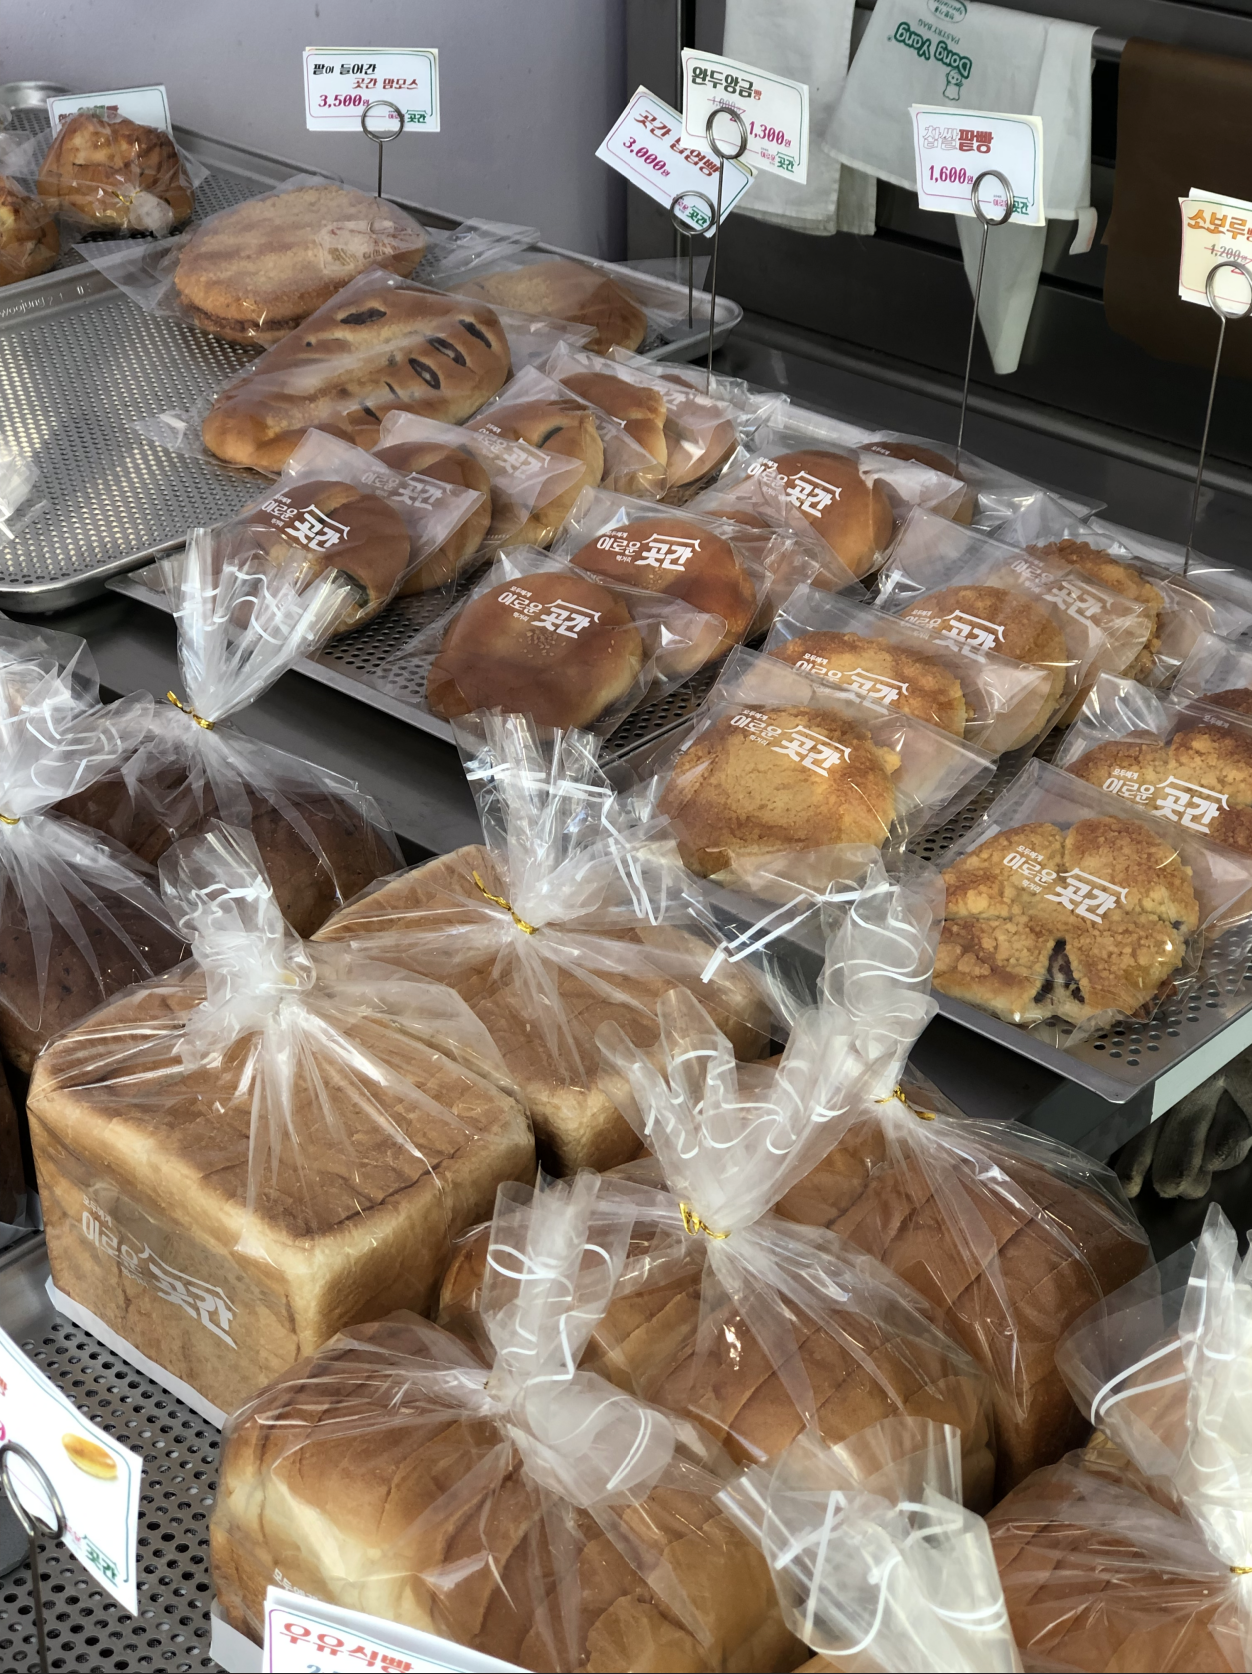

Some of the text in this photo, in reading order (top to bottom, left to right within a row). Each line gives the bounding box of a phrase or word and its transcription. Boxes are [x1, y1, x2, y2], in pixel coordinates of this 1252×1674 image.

[894, 22, 972, 79] Dong Yang
[917, 18, 961, 45] PASTRY BAG
[339, 64, 377, 75] 들어간
[352, 78, 418, 90] 곳간 맘모스
[407, 113, 426, 124] 곳간
[633, 110, 672, 141] 곳간
[749, 121, 791, 147] 1,300원
[777, 156, 794, 173] 곳간
[686, 208, 708, 228] 곳간
[494, 447, 543, 479] 곳간
[390, 480, 443, 510] 곳간
[779, 479, 833, 518] 곳간
[262, 499, 341, 552] 이로운 곳간
[596, 537, 693, 571] 이로운 곳간
[498, 592, 591, 638] 이로운 곳간
[1042, 581, 1103, 626] 곳간
[932, 619, 996, 664] 곳간
[826, 675, 899, 715] 곳간
[730, 715, 841, 777] 이로운 곳간
[1102, 777, 1220, 834] 이로운 곳간
[1003, 853, 1117, 924] 이로운 곳간
[82, 1211, 237, 1350] 이로운 곳간
[280, 1622, 414, 1673] 우유식빵
